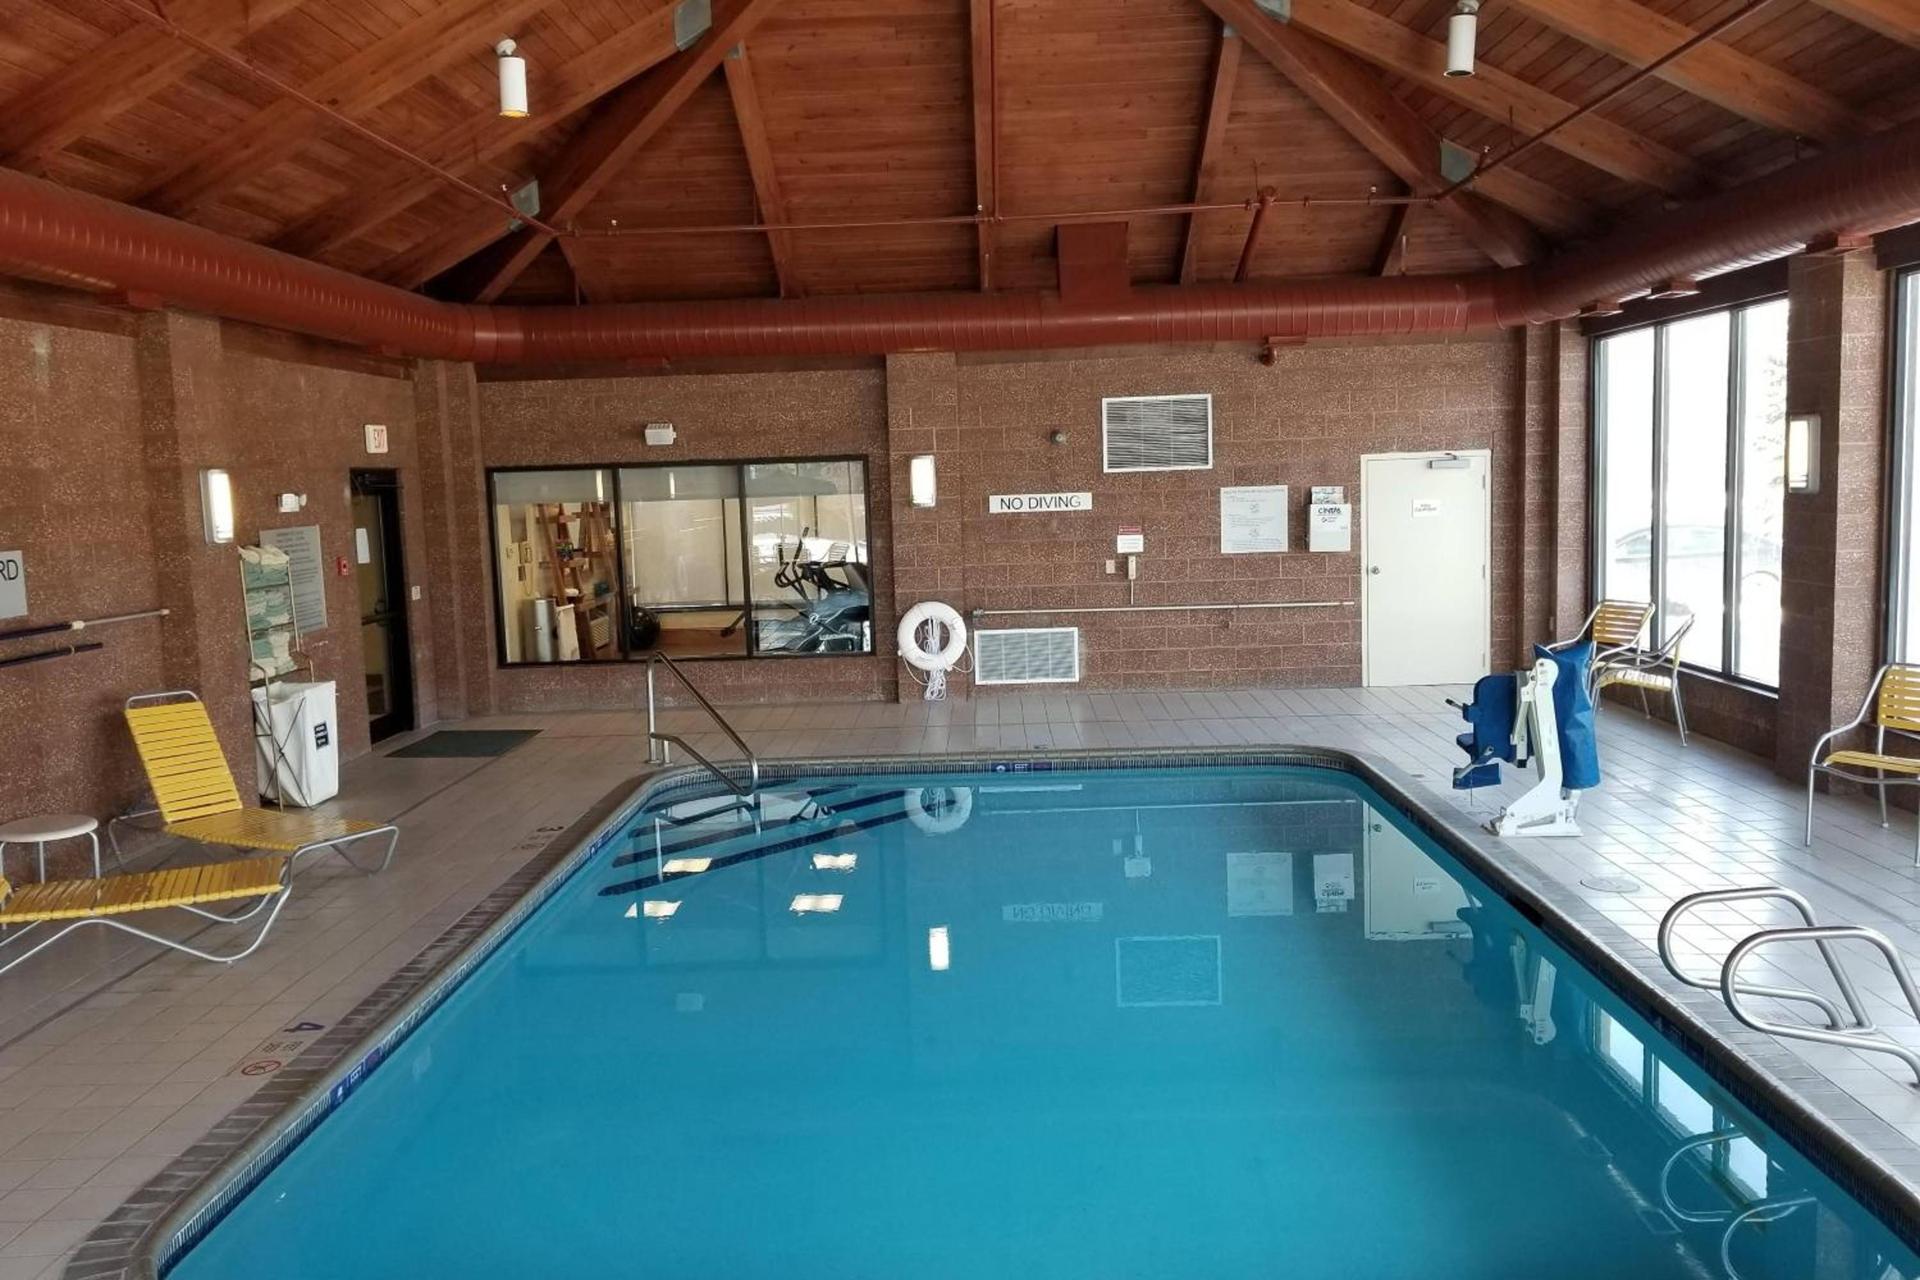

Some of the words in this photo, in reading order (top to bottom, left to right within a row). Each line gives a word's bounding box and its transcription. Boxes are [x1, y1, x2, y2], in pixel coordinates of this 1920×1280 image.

[1000, 497, 1023, 511] NO
[1028, 495, 1081, 509] DIVING
[284, 1022, 325, 1033] 4
